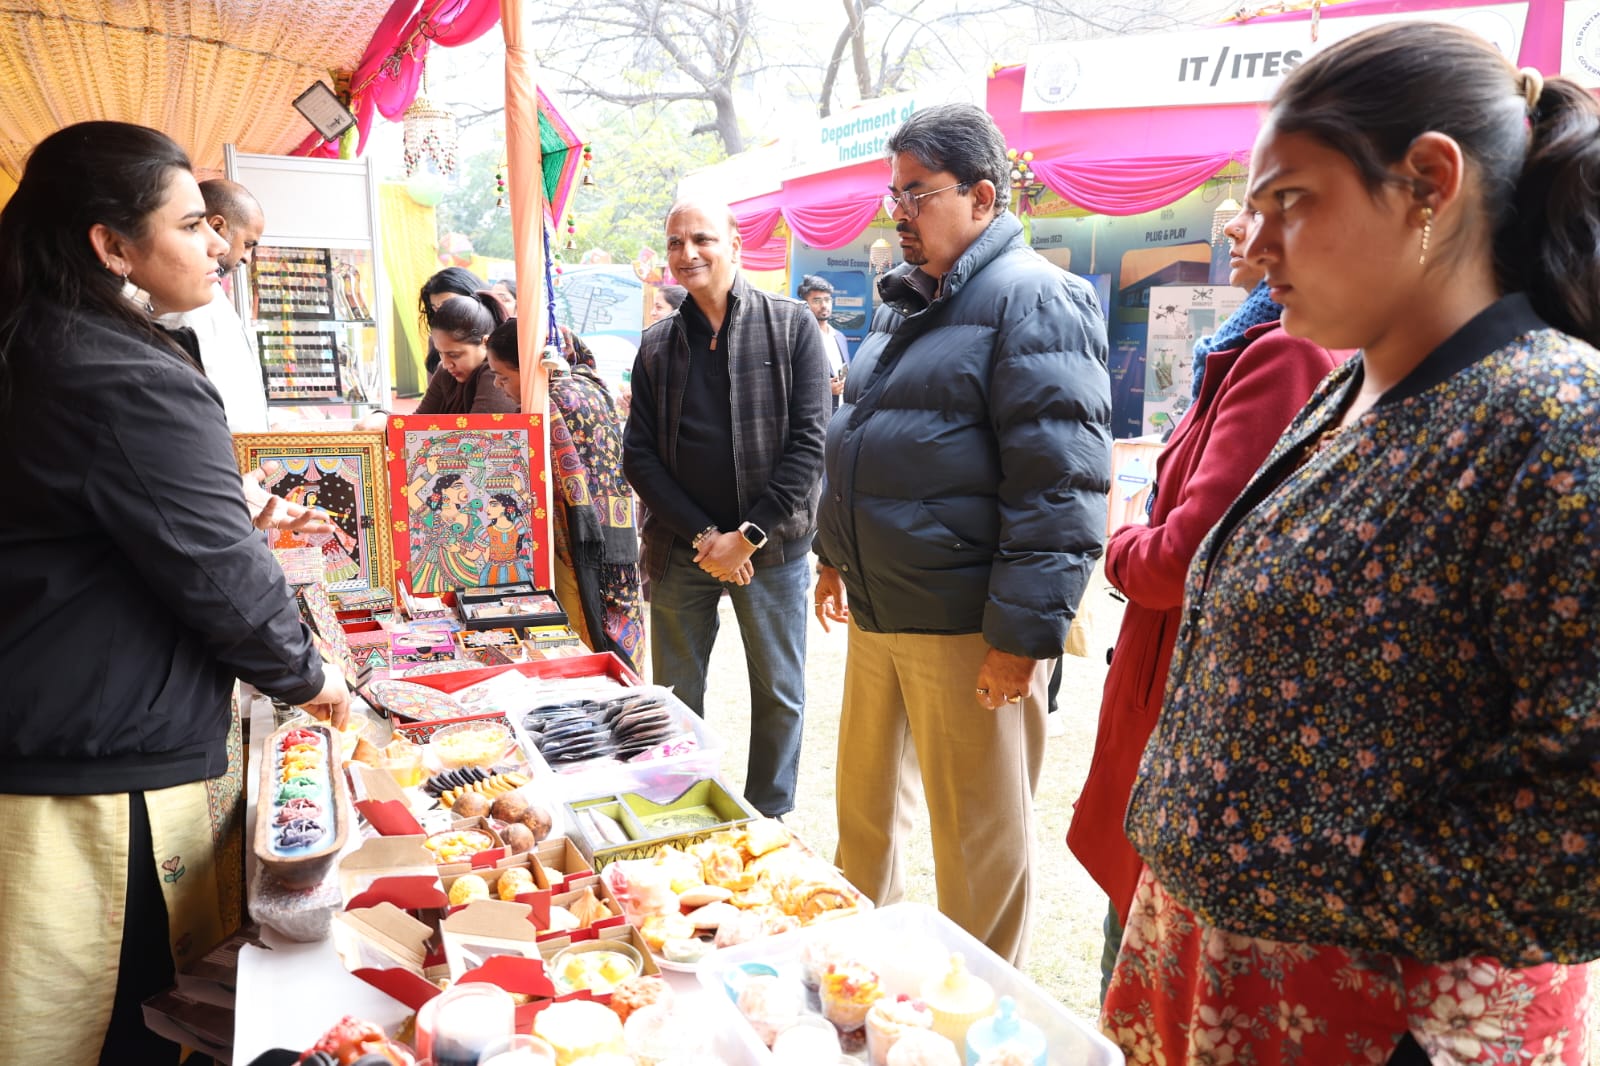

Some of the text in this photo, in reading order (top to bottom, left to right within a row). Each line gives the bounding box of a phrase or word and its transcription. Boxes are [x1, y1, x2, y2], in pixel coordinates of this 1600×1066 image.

[821, 99, 914, 146] Department of
[1145, 230, 1163, 242] PLUG
[1170, 226, 1187, 240] PLAY
